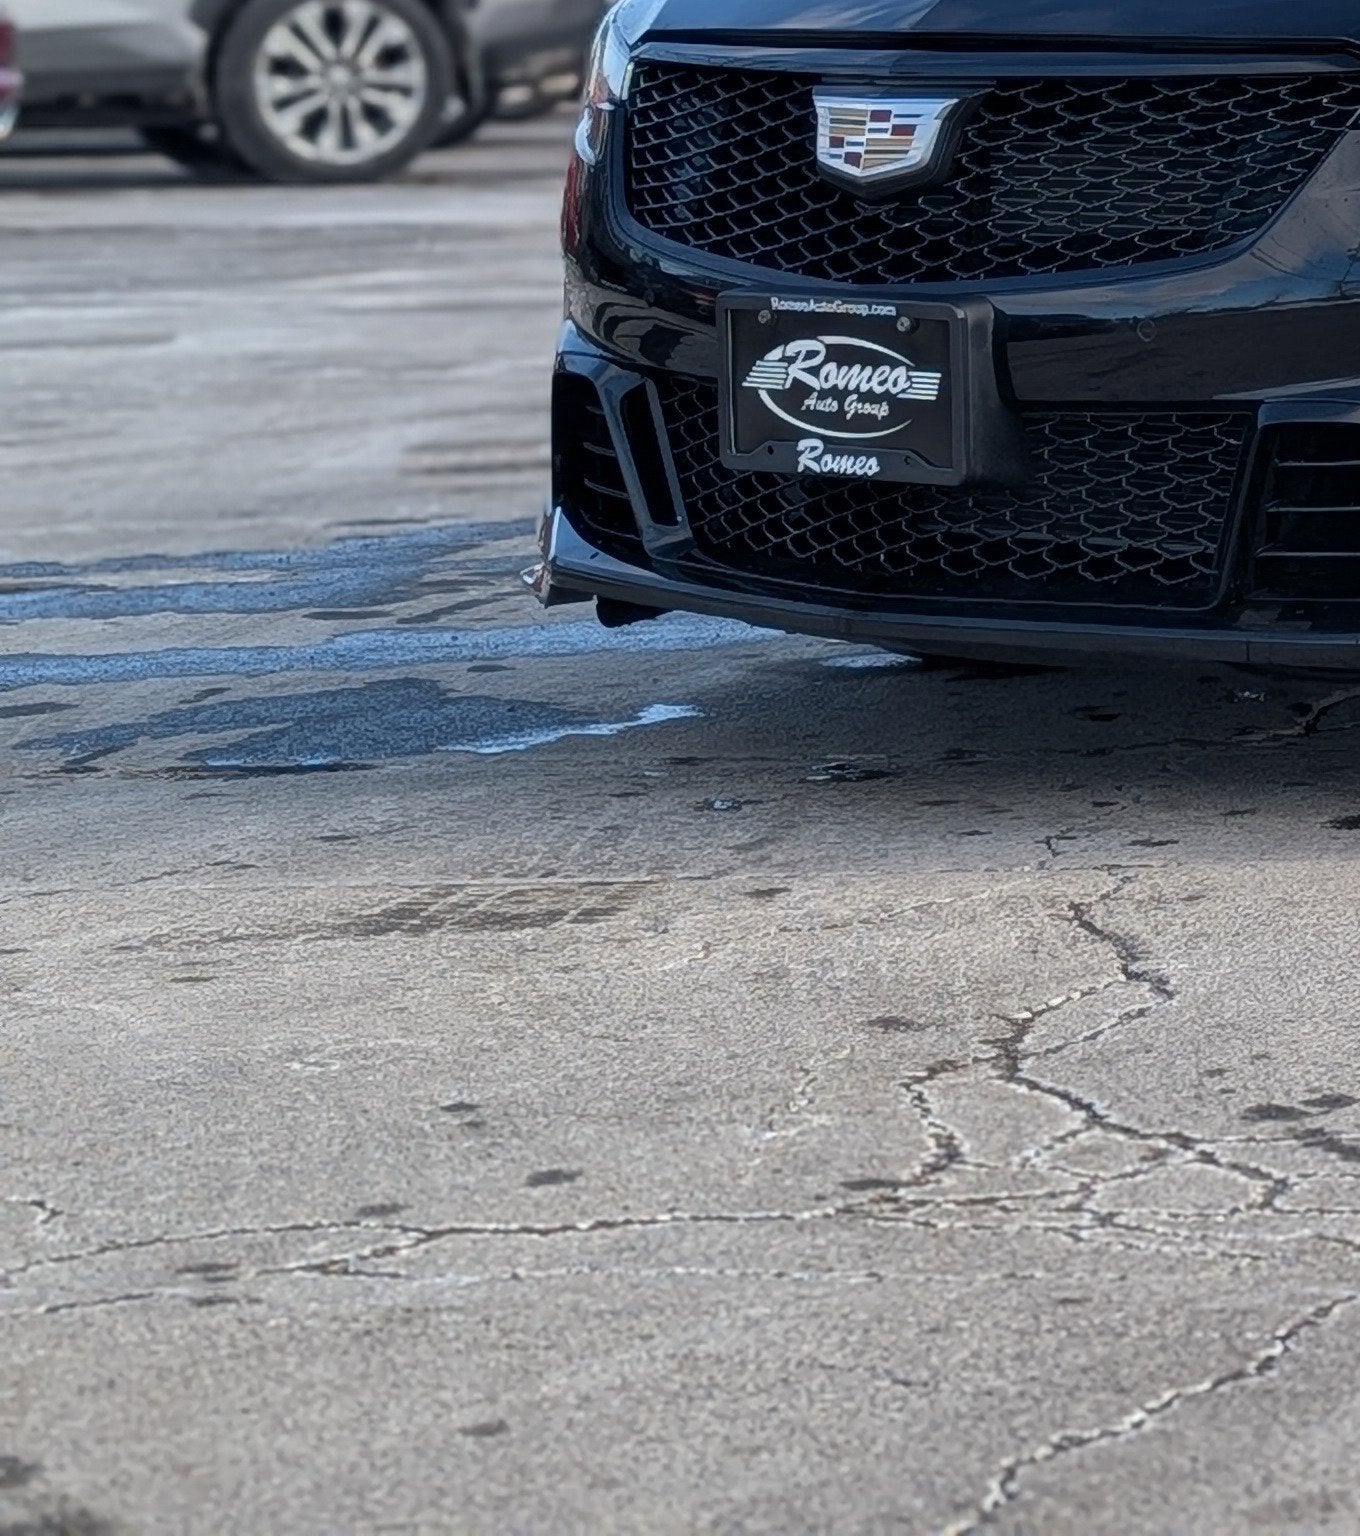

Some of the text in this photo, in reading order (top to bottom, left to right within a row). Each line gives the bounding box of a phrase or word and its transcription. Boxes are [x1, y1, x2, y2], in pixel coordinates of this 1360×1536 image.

[784, 339, 910, 394] Romeo
[801, 392, 889, 420] Auto Group
[797, 438, 880, 476] Romeo
